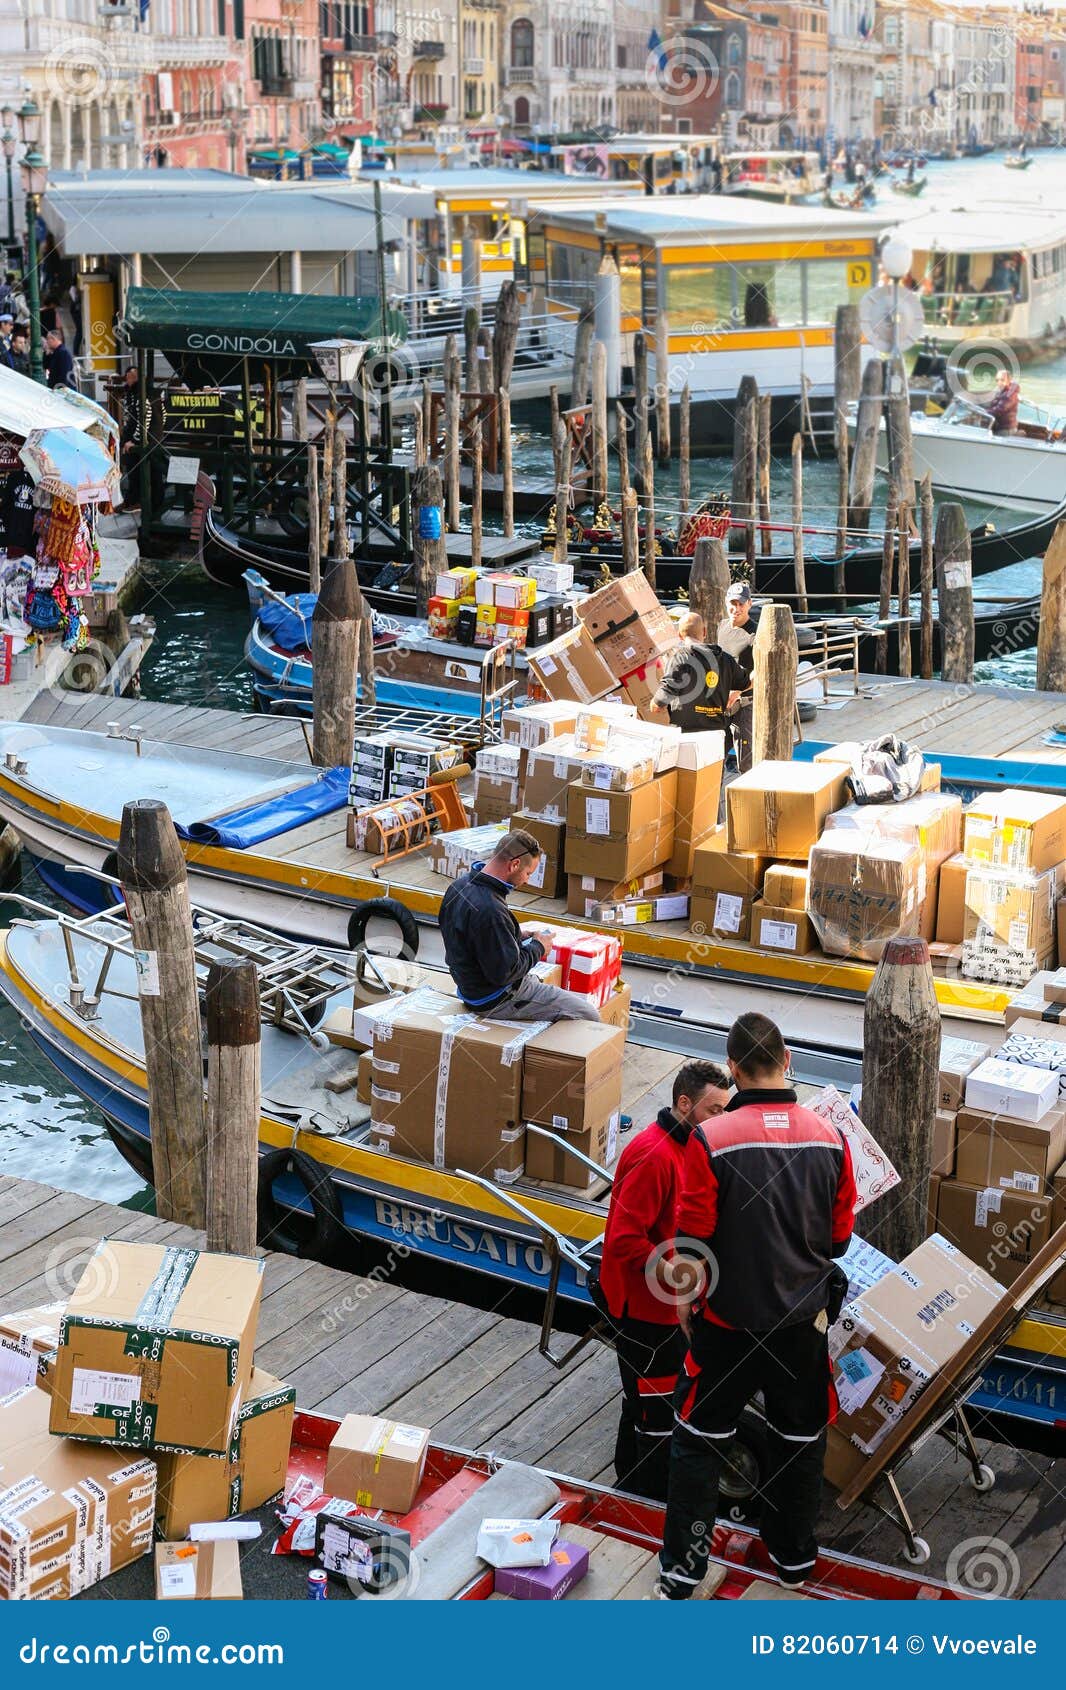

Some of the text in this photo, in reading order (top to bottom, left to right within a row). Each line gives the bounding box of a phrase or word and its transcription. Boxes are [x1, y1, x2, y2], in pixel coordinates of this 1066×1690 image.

[187, 333, 297, 355] GONDOLA
[171, 395, 220, 407] WATERTAXI
[183, 418, 206, 429] TAXI
[375, 1200, 552, 1276] BRUSATO
[82, 1317, 123, 1328] GEOX
[137, 1324, 178, 1337] GEOX
[190, 1333, 232, 1346] GEOX
[1, 1339, 32, 1359] Baldinini
[231, 1349, 239, 1385] GEOX
[261, 1394, 289, 1410] GEOX
[154, 1445, 196, 1456] GEOX
